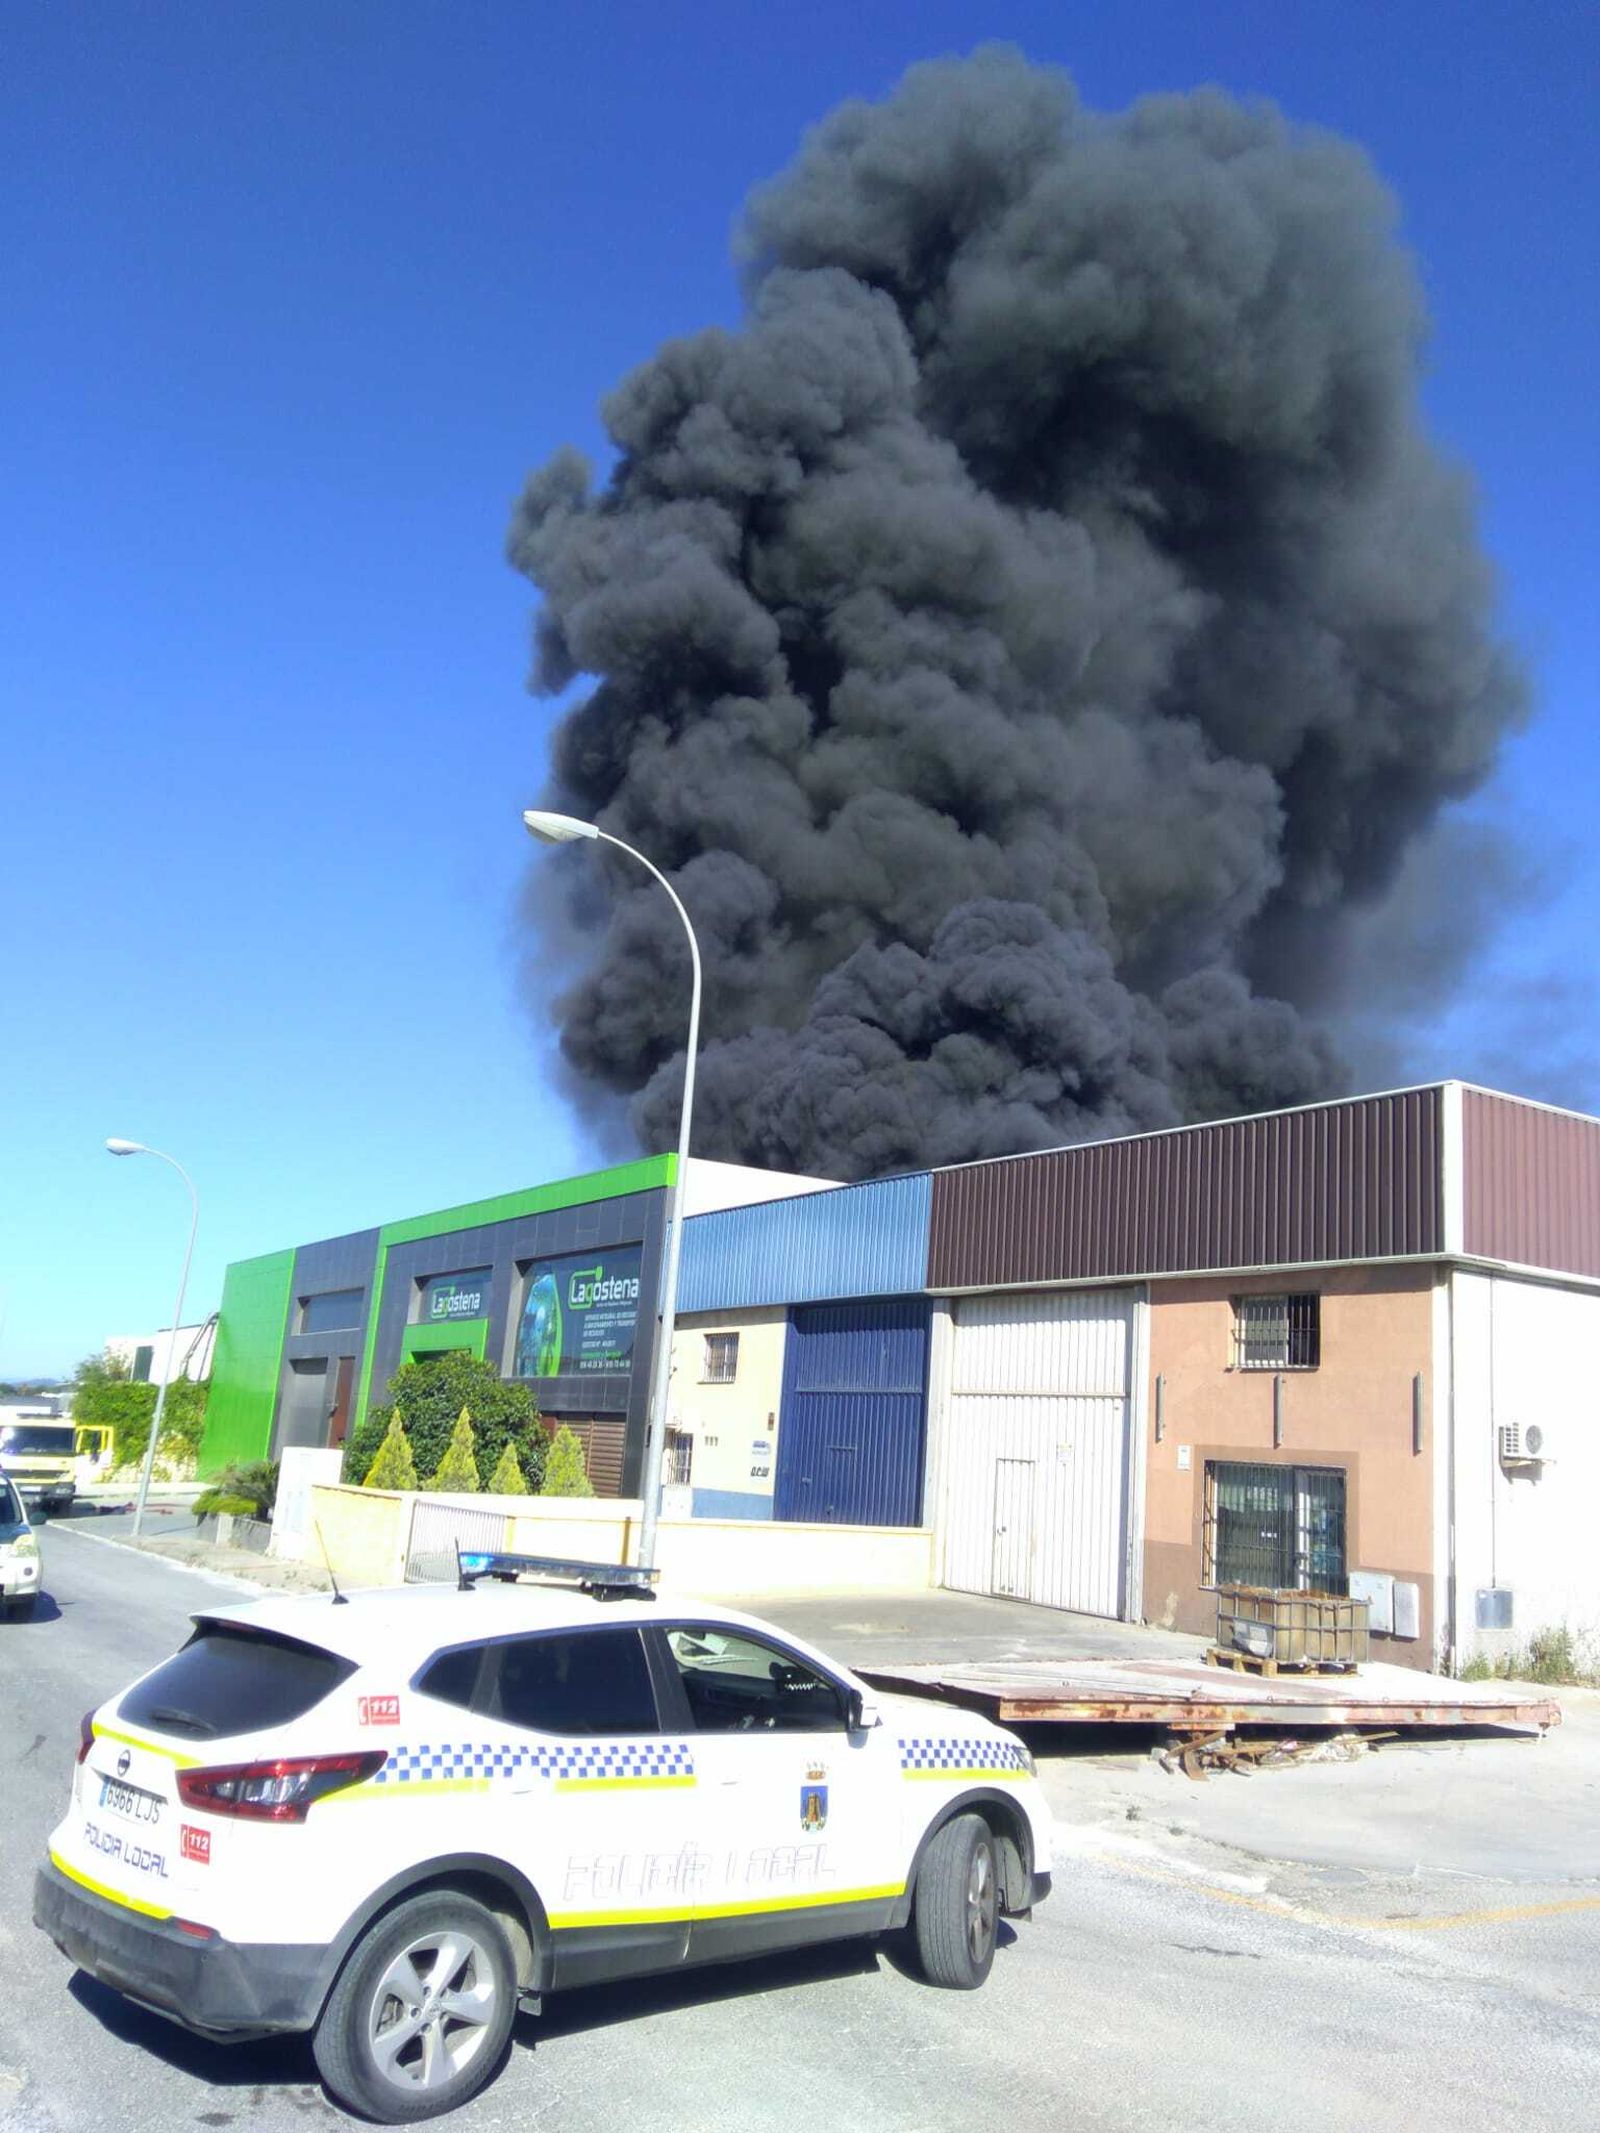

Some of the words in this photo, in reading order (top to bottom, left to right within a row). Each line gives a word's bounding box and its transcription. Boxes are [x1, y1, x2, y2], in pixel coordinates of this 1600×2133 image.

[431, 1290, 481, 1314] Lagostena
[570, 1275, 640, 1305] Lagostena
[370, 1699, 398, 1714] 112
[135, 1791, 162, 1825] LJS
[189, 1833, 209, 1851] 112
[123, 1841, 169, 1878] LOCAL
